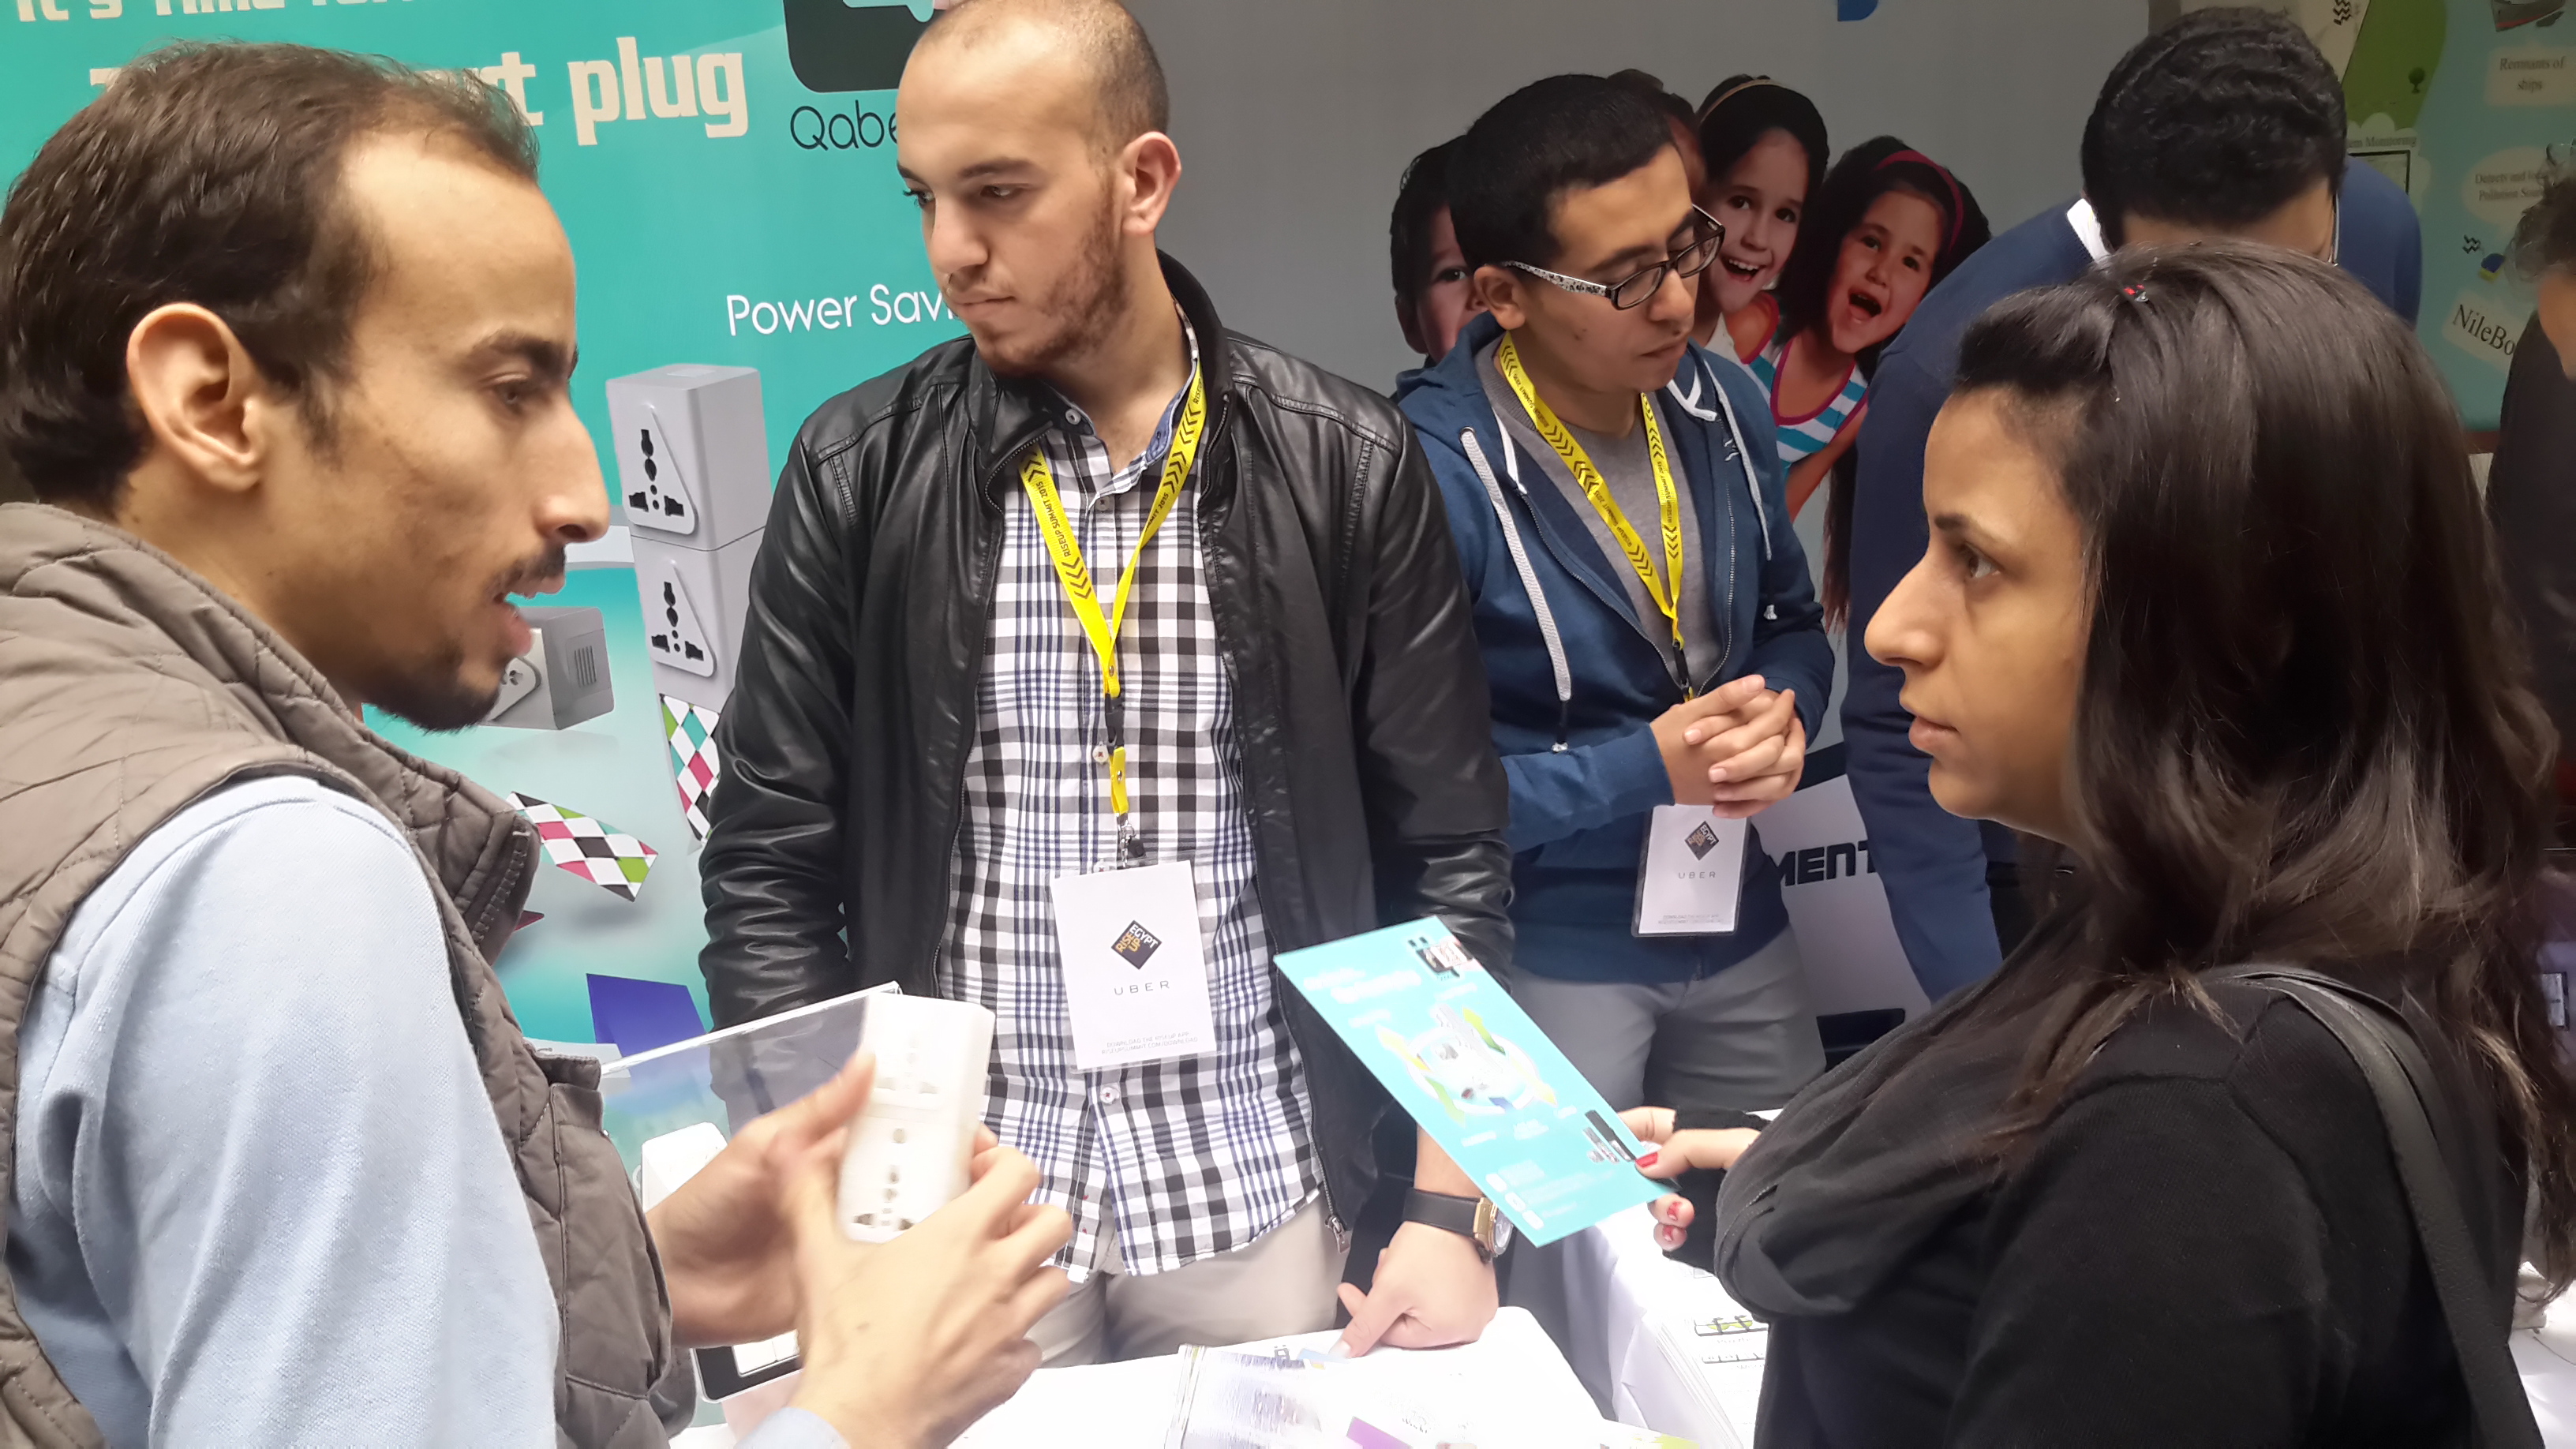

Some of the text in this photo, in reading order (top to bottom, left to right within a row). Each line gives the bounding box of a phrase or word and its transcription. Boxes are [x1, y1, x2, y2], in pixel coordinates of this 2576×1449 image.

[567, 36, 749, 146] plug
[726, 294, 857, 336] Power
[1158, 492, 1170, 510] 2015
[1036, 481, 1071, 557] RISEUP SUMMIT 2015
[1678, 871, 1717, 880] UBER
[1115, 931, 1135, 953] RISE
[1129, 923, 1159, 949] EGYPT
[1129, 937, 1141, 952] UP
[1114, 980, 1170, 996] UBER
